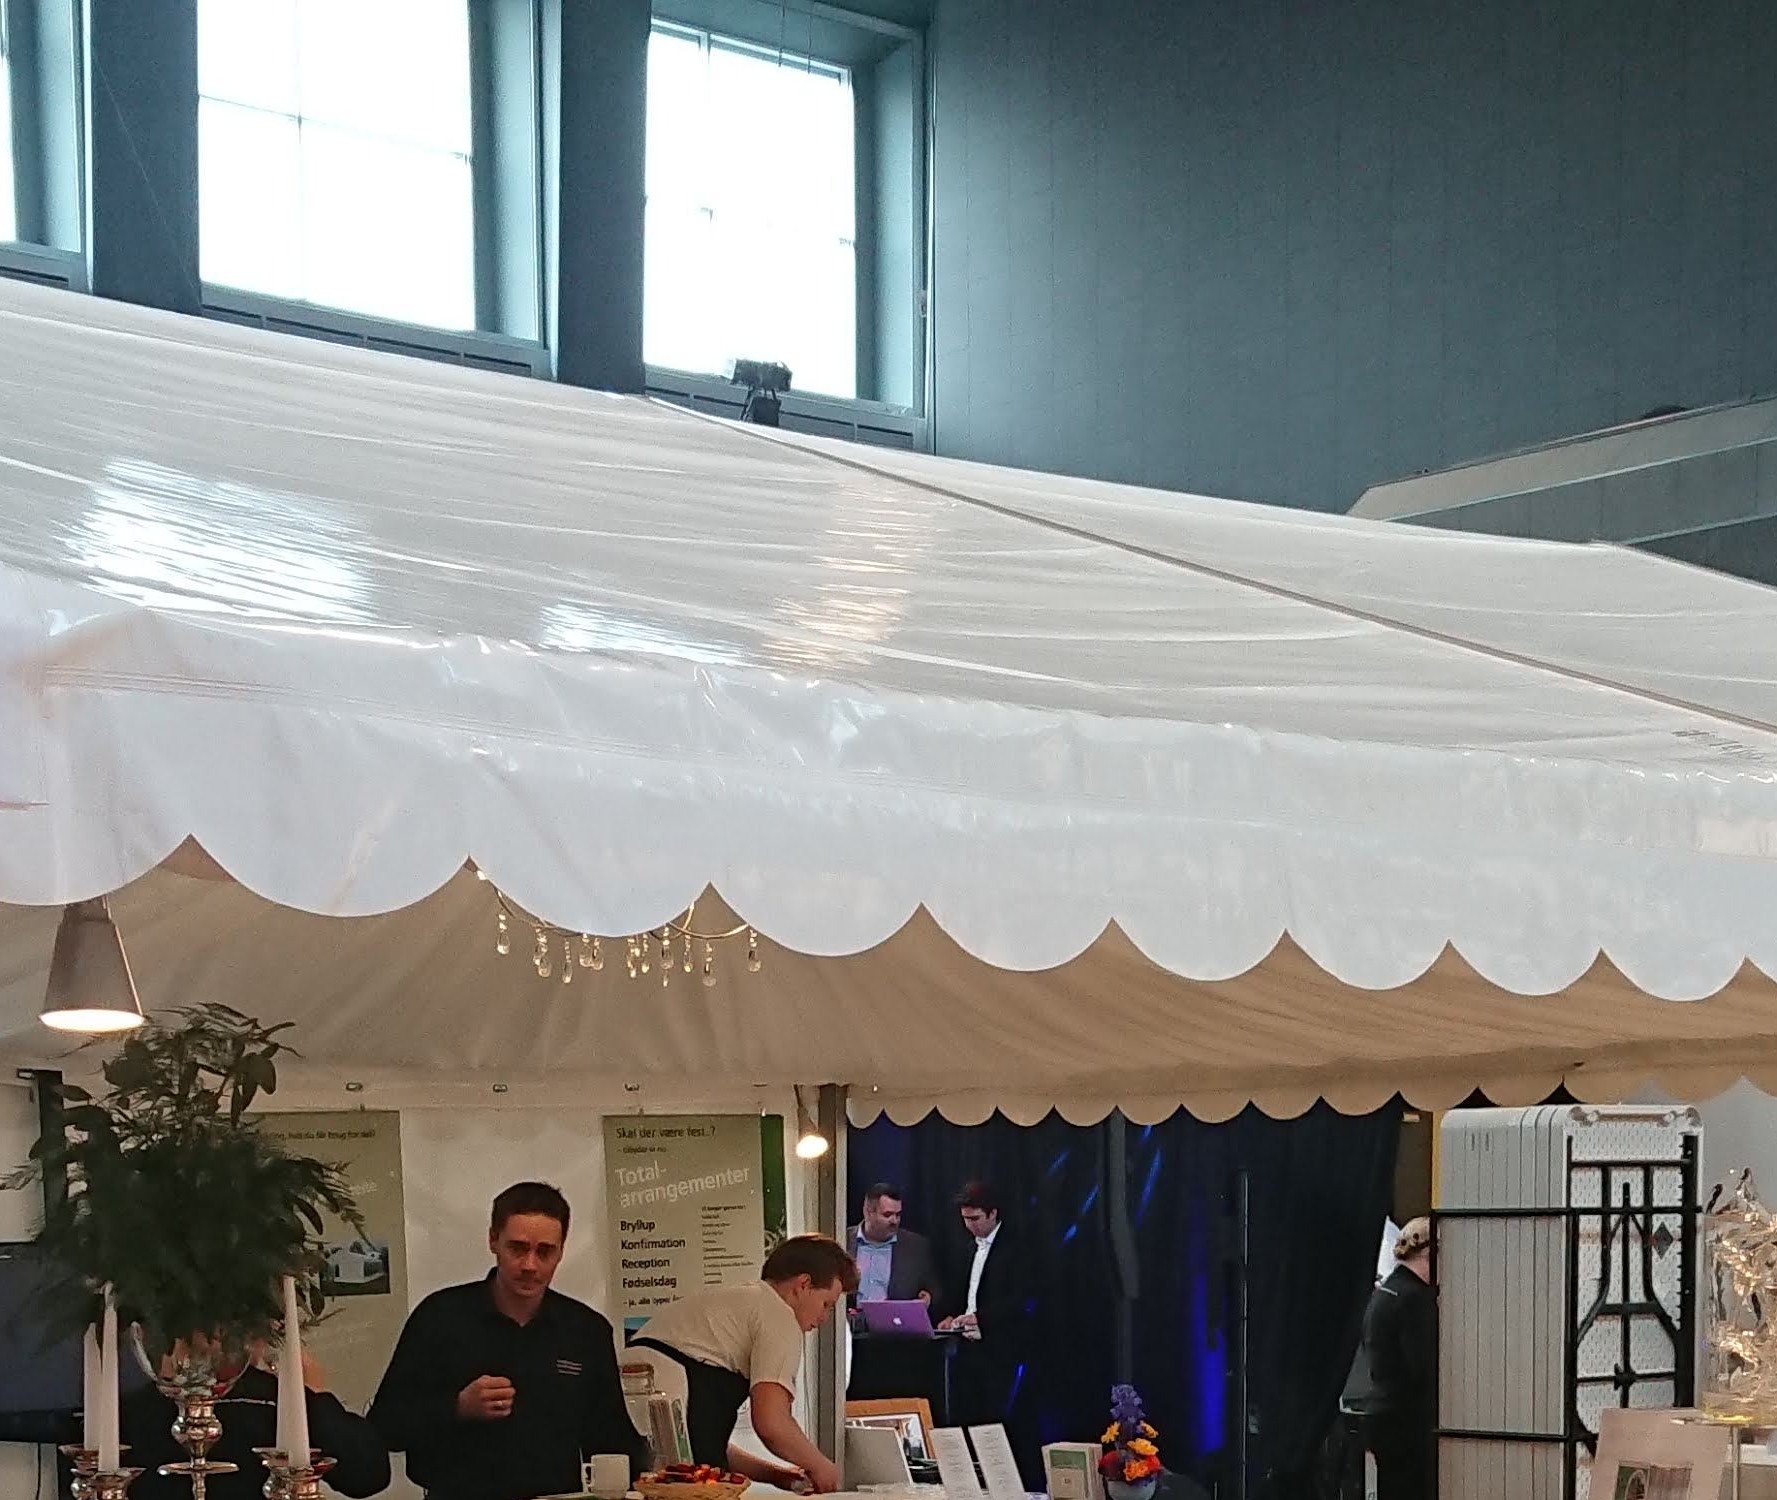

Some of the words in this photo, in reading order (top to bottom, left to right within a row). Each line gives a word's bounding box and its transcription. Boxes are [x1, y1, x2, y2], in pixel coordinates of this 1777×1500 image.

[615, 1160, 668, 1187] Total-
[620, 1167, 751, 1208] arrangementer
[620, 1219, 655, 1232] Bryllup
[621, 1238, 685, 1250] Konfirmation
[622, 1257, 670, 1270] Reception
[622, 1276, 677, 1289] Fødselsdag
